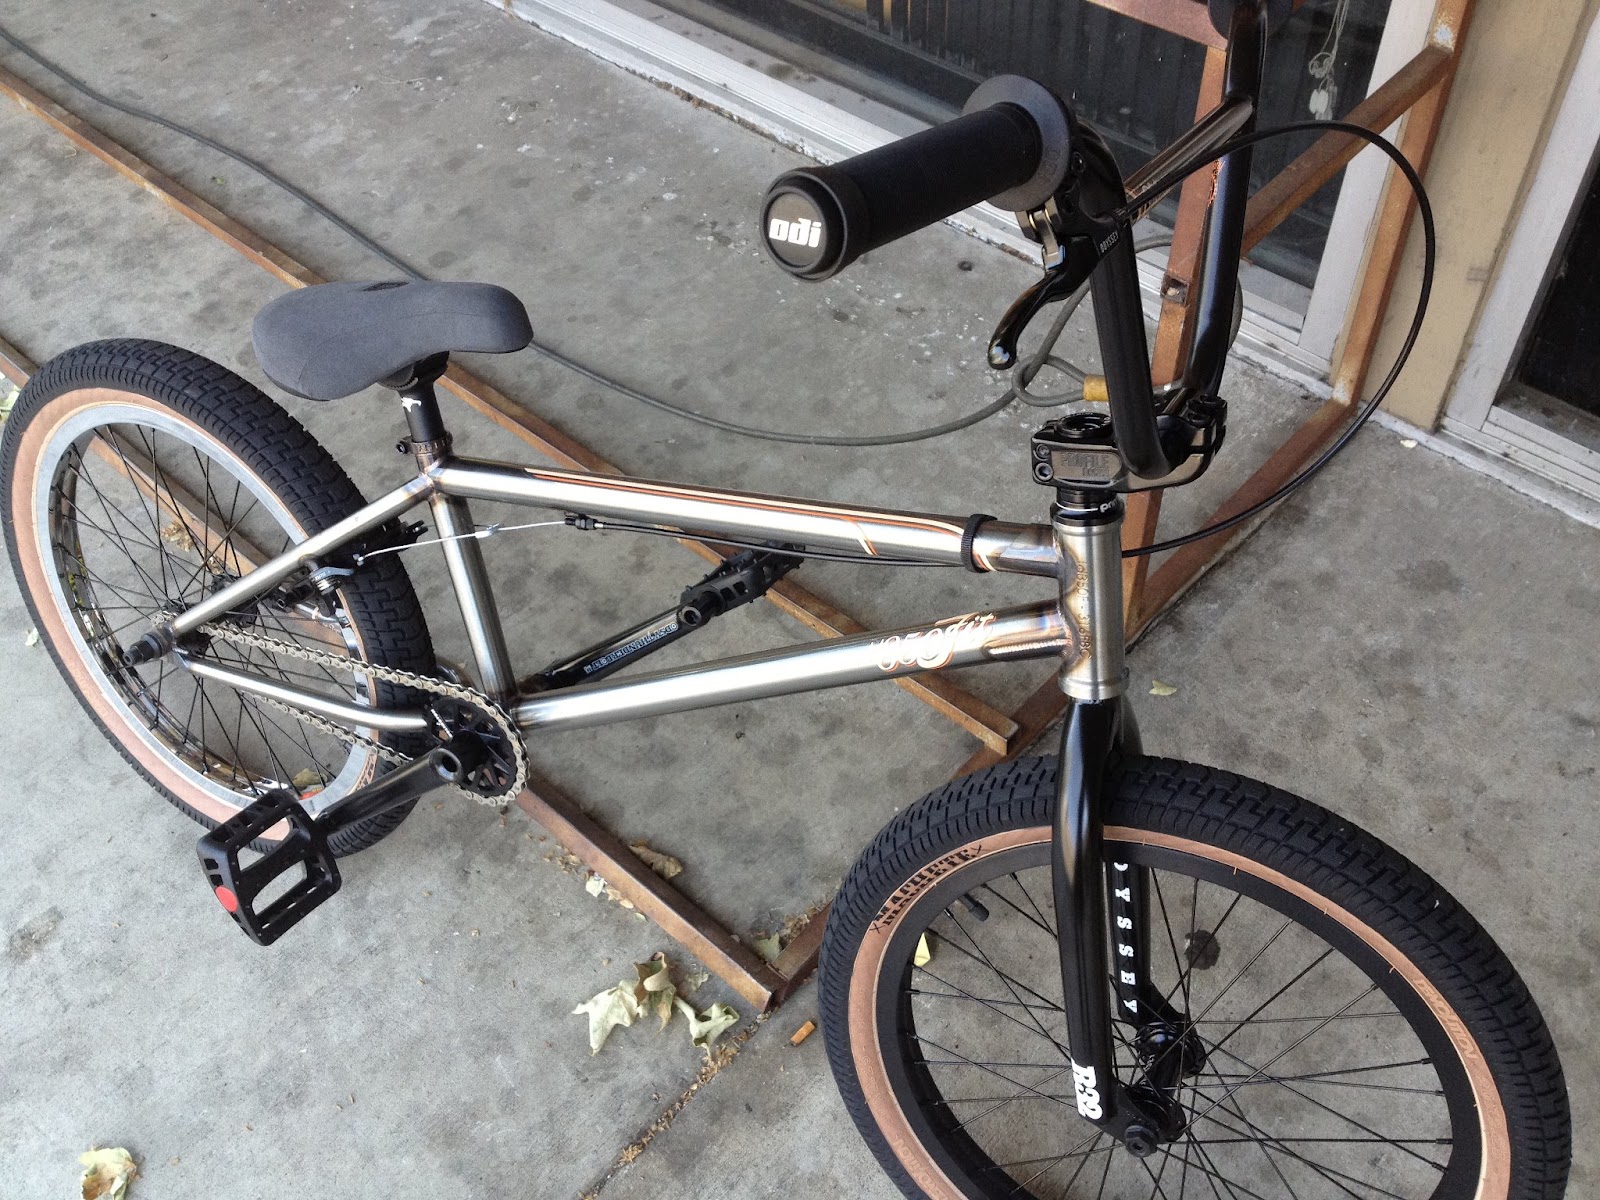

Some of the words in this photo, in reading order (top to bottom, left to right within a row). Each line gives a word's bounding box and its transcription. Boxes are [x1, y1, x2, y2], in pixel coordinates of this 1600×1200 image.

[769, 217, 822, 248] odi
[1100, 231, 1119, 253] ODYSSEY
[875, 849, 977, 926] MACHETE
[1071, 1057, 1103, 1120] R32
